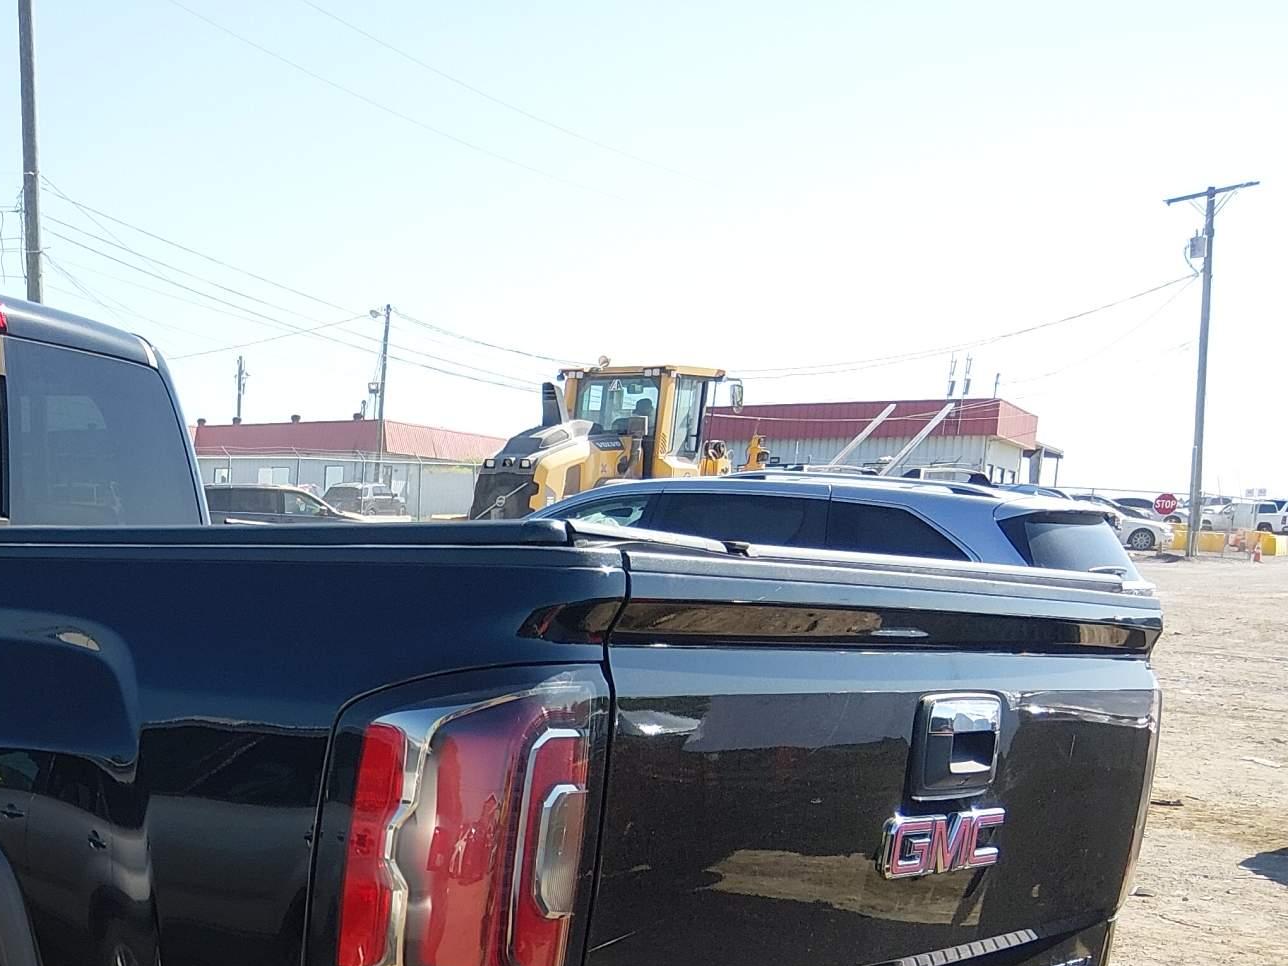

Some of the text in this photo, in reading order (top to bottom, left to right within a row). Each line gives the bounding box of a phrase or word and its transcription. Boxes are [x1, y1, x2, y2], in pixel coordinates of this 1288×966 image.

[596, 440, 621, 448] VOLVO
[1155, 499, 1177, 509] STOP
[877, 807, 1006, 880] GMC
